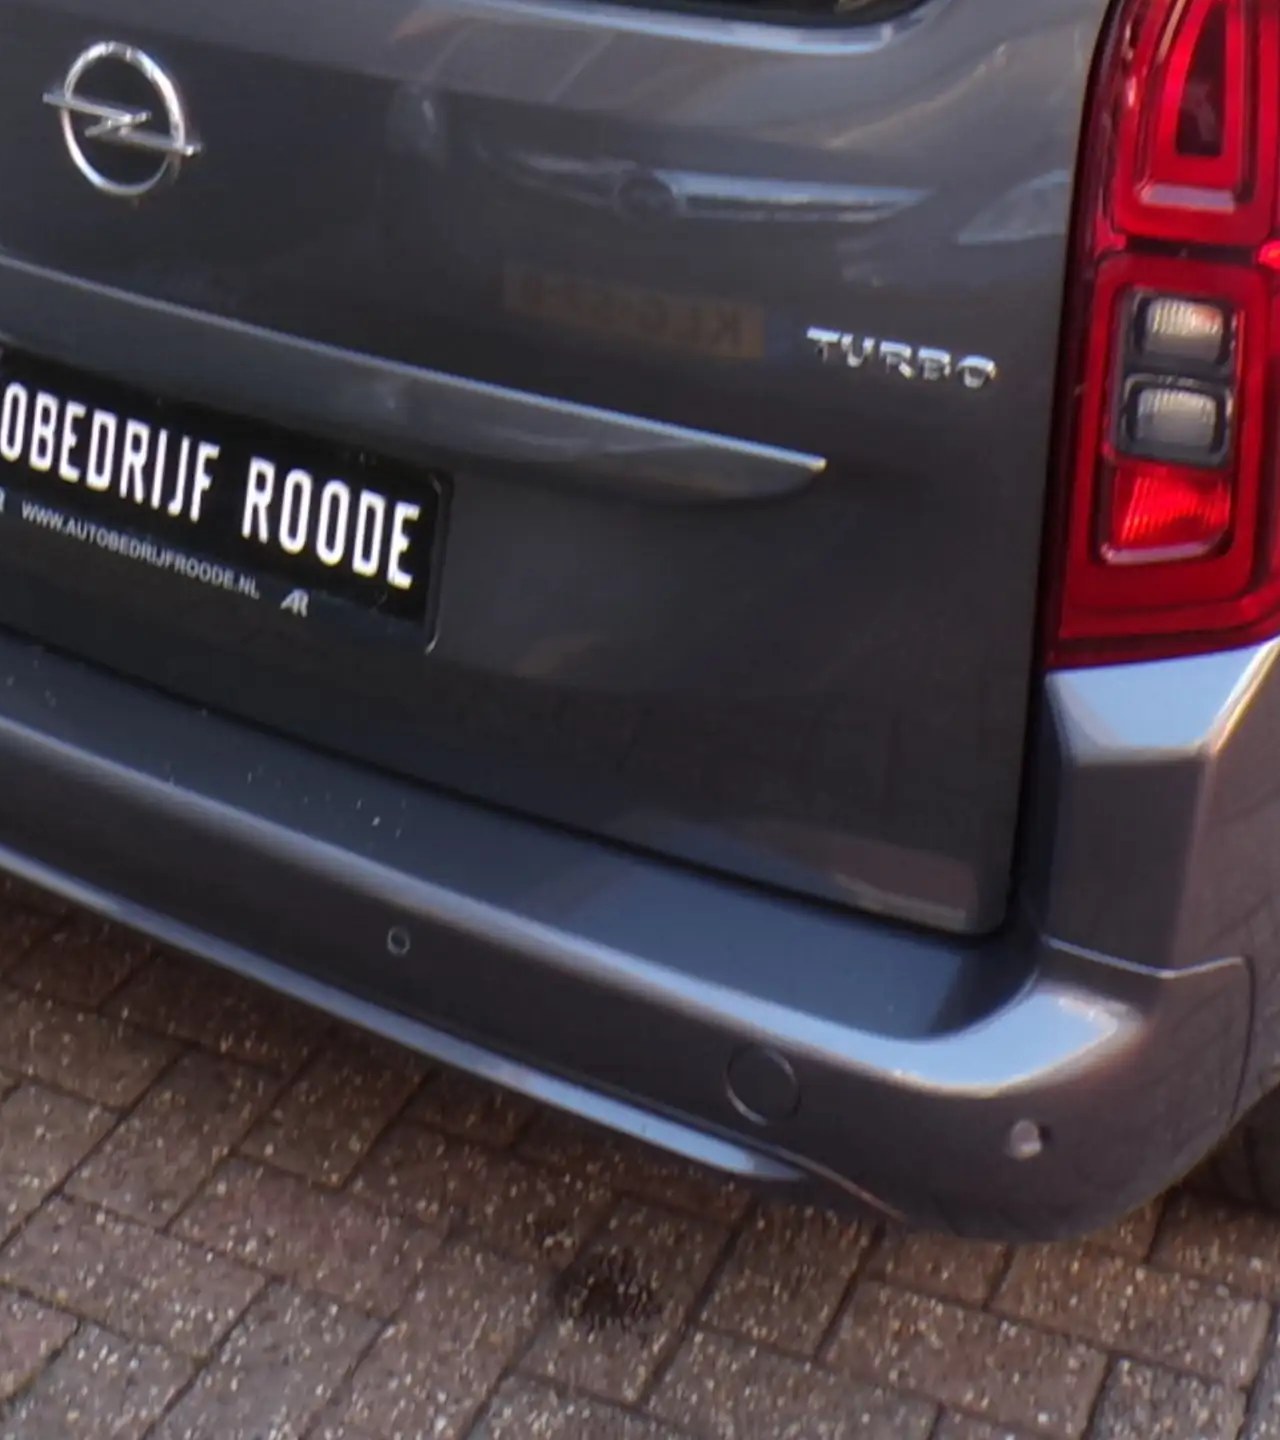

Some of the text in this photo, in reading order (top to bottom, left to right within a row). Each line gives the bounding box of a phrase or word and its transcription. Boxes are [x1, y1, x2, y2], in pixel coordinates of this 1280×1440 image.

[807, 326, 997, 388] TURBO
[21, 500, 260, 599] WWW.AUTOBEDRIJFROODE.NL
[241, 457, 420, 589] ROODE
